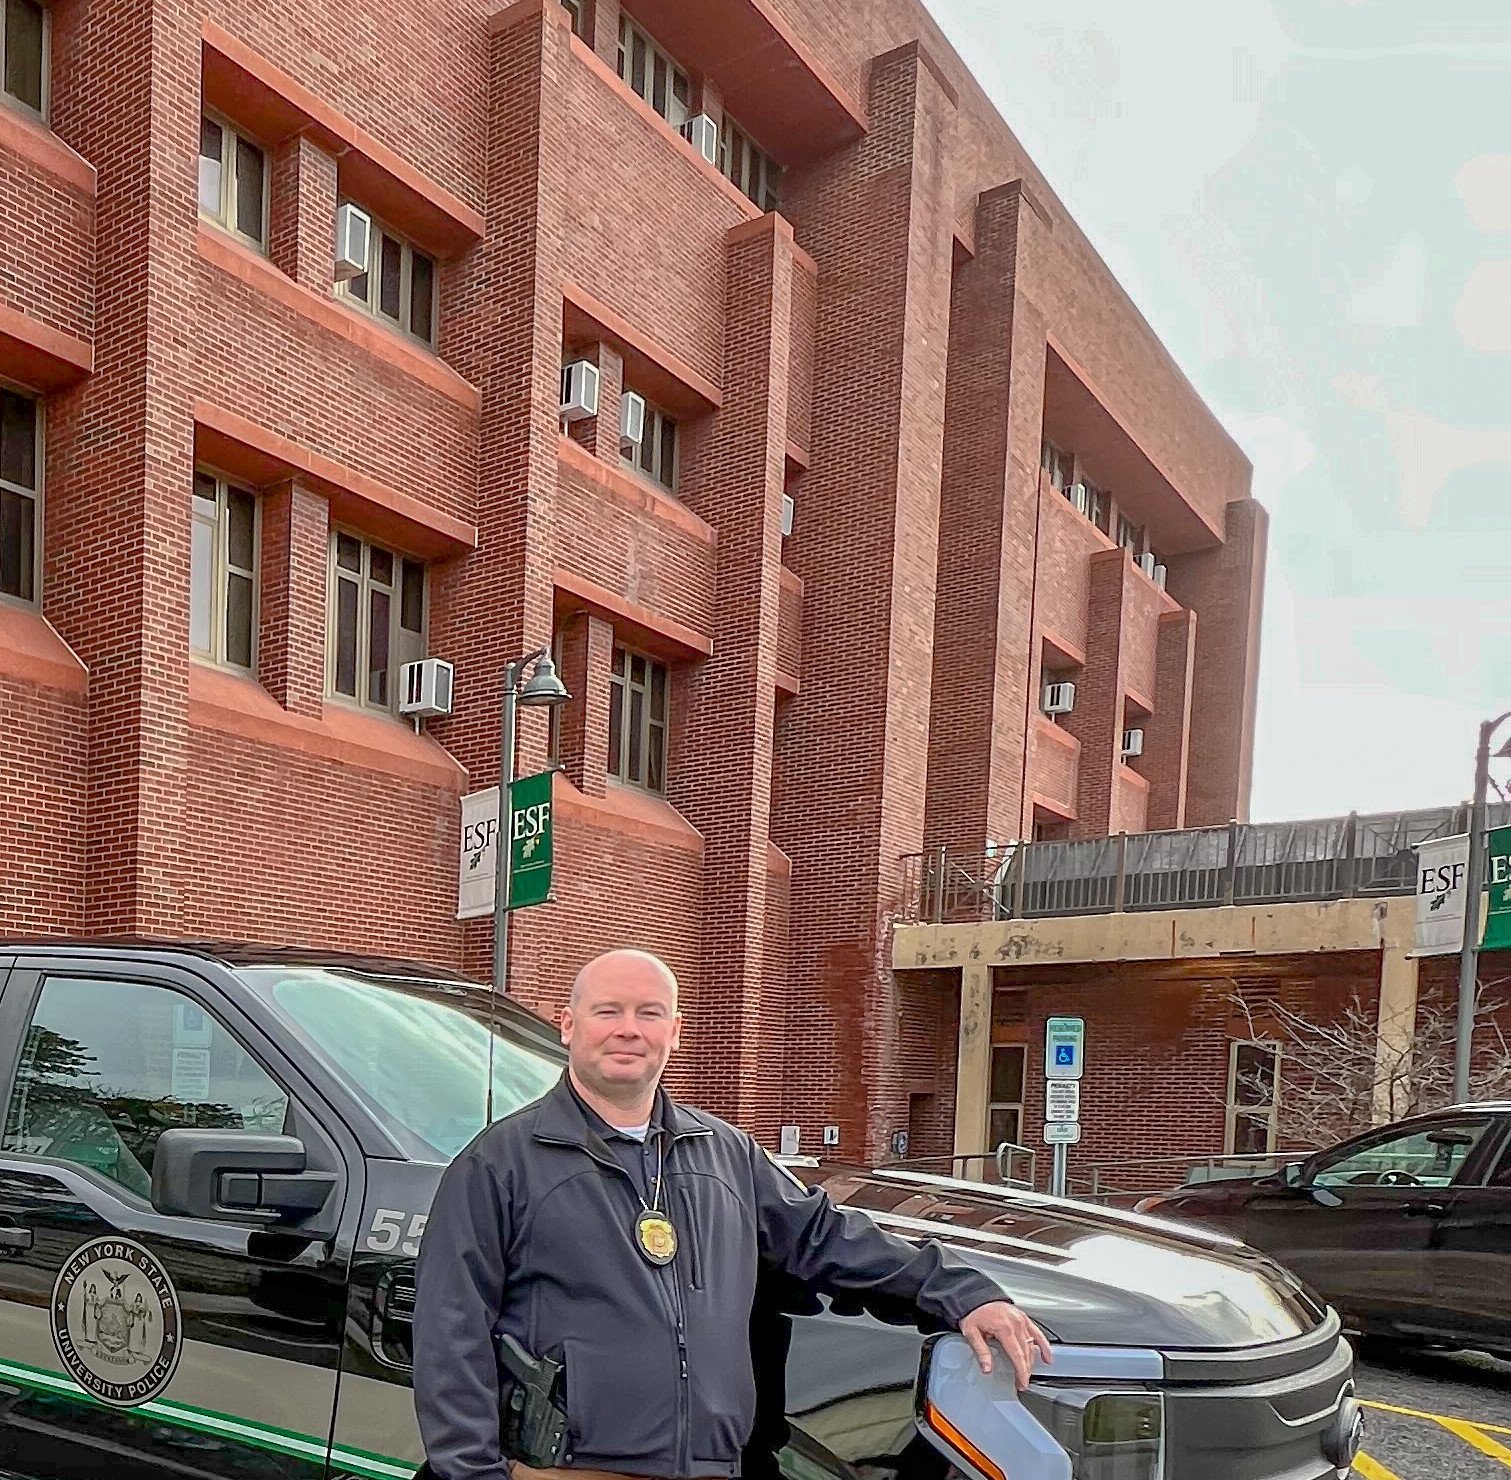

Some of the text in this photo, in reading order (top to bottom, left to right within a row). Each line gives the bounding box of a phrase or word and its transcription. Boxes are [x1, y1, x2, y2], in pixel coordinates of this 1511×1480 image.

[463, 818, 497, 853] ESF
[513, 802, 551, 841] ESF
[1420, 862, 1466, 895] ESF
[64, 1244, 174, 1309] NEW YORK STATE
[58, 1328, 170, 1398] UNIVERSITY POLICE
